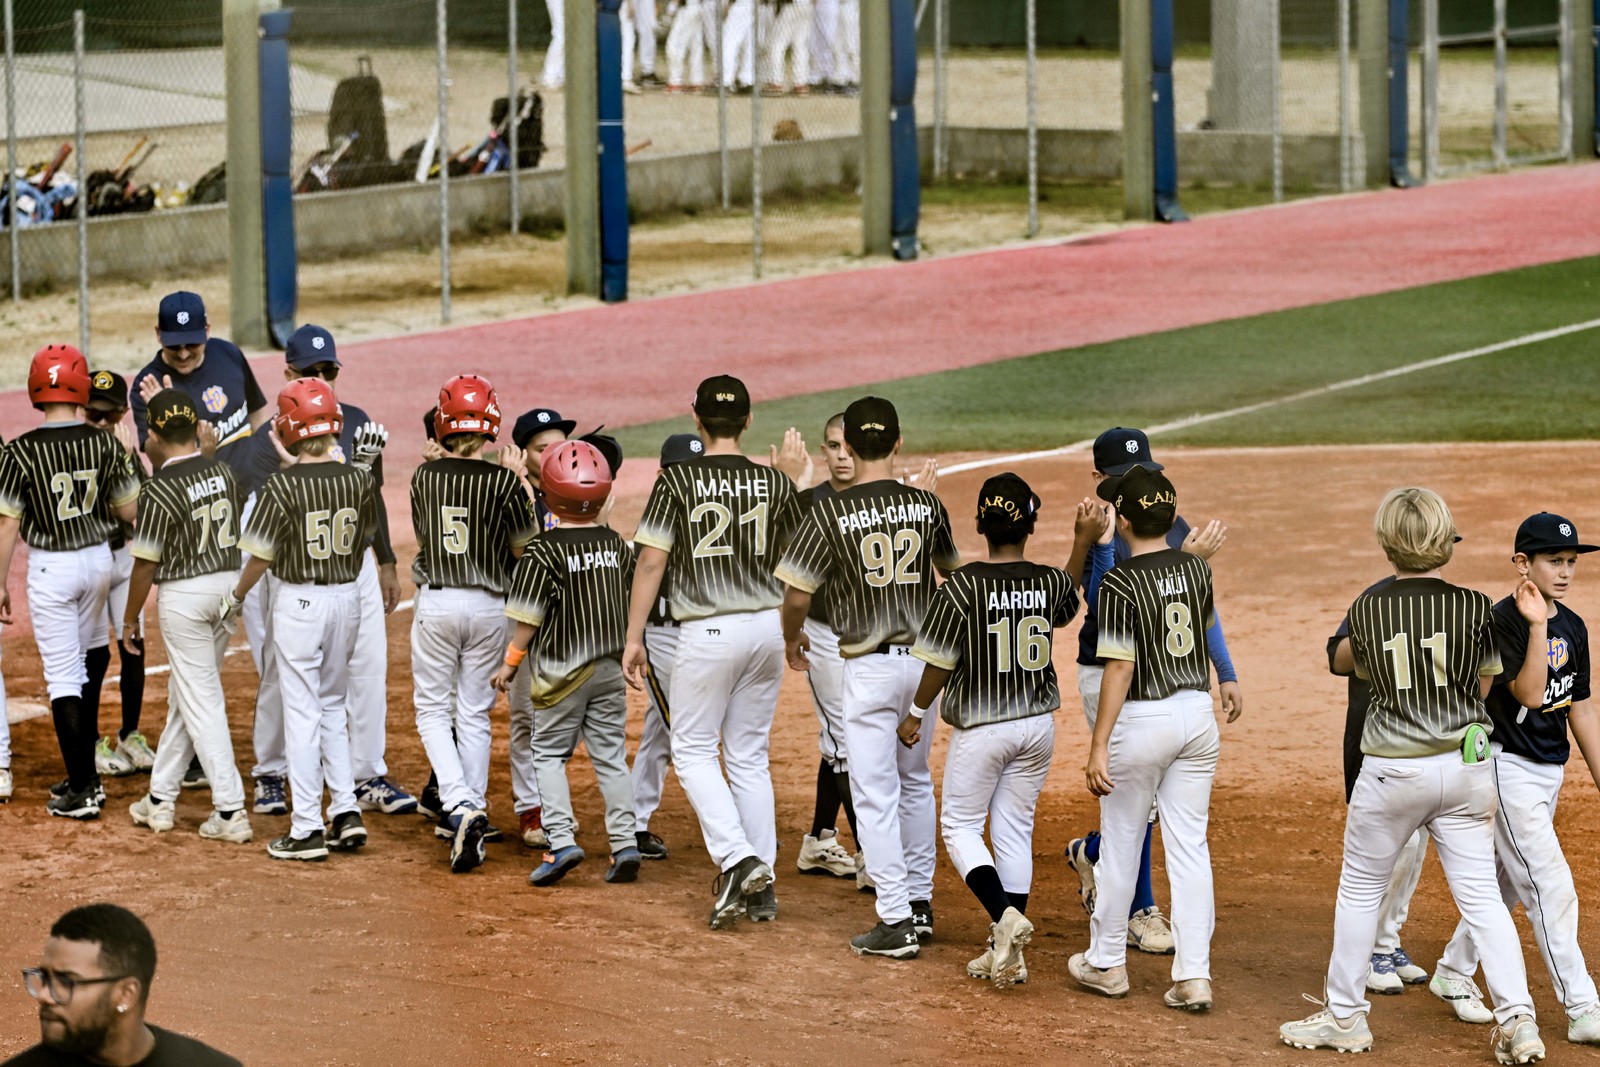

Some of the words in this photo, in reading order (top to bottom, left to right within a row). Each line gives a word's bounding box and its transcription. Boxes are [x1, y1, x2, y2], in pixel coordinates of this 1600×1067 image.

[51, 468, 99, 522] 27
[696, 479, 769, 498] MAHE
[979, 495, 1024, 522] AARON
[192, 498, 237, 554] 72
[306, 507, 358, 560] 56
[441, 505, 469, 555] 5
[690, 501, 768, 559] 21
[567, 550, 619, 573] M.PACK
[860, 528, 922, 588] 92
[988, 590, 1047, 611] AARON
[987, 616, 1050, 673] 16
[1165, 602, 1195, 658] 8
[1383, 632, 1448, 689] 11
